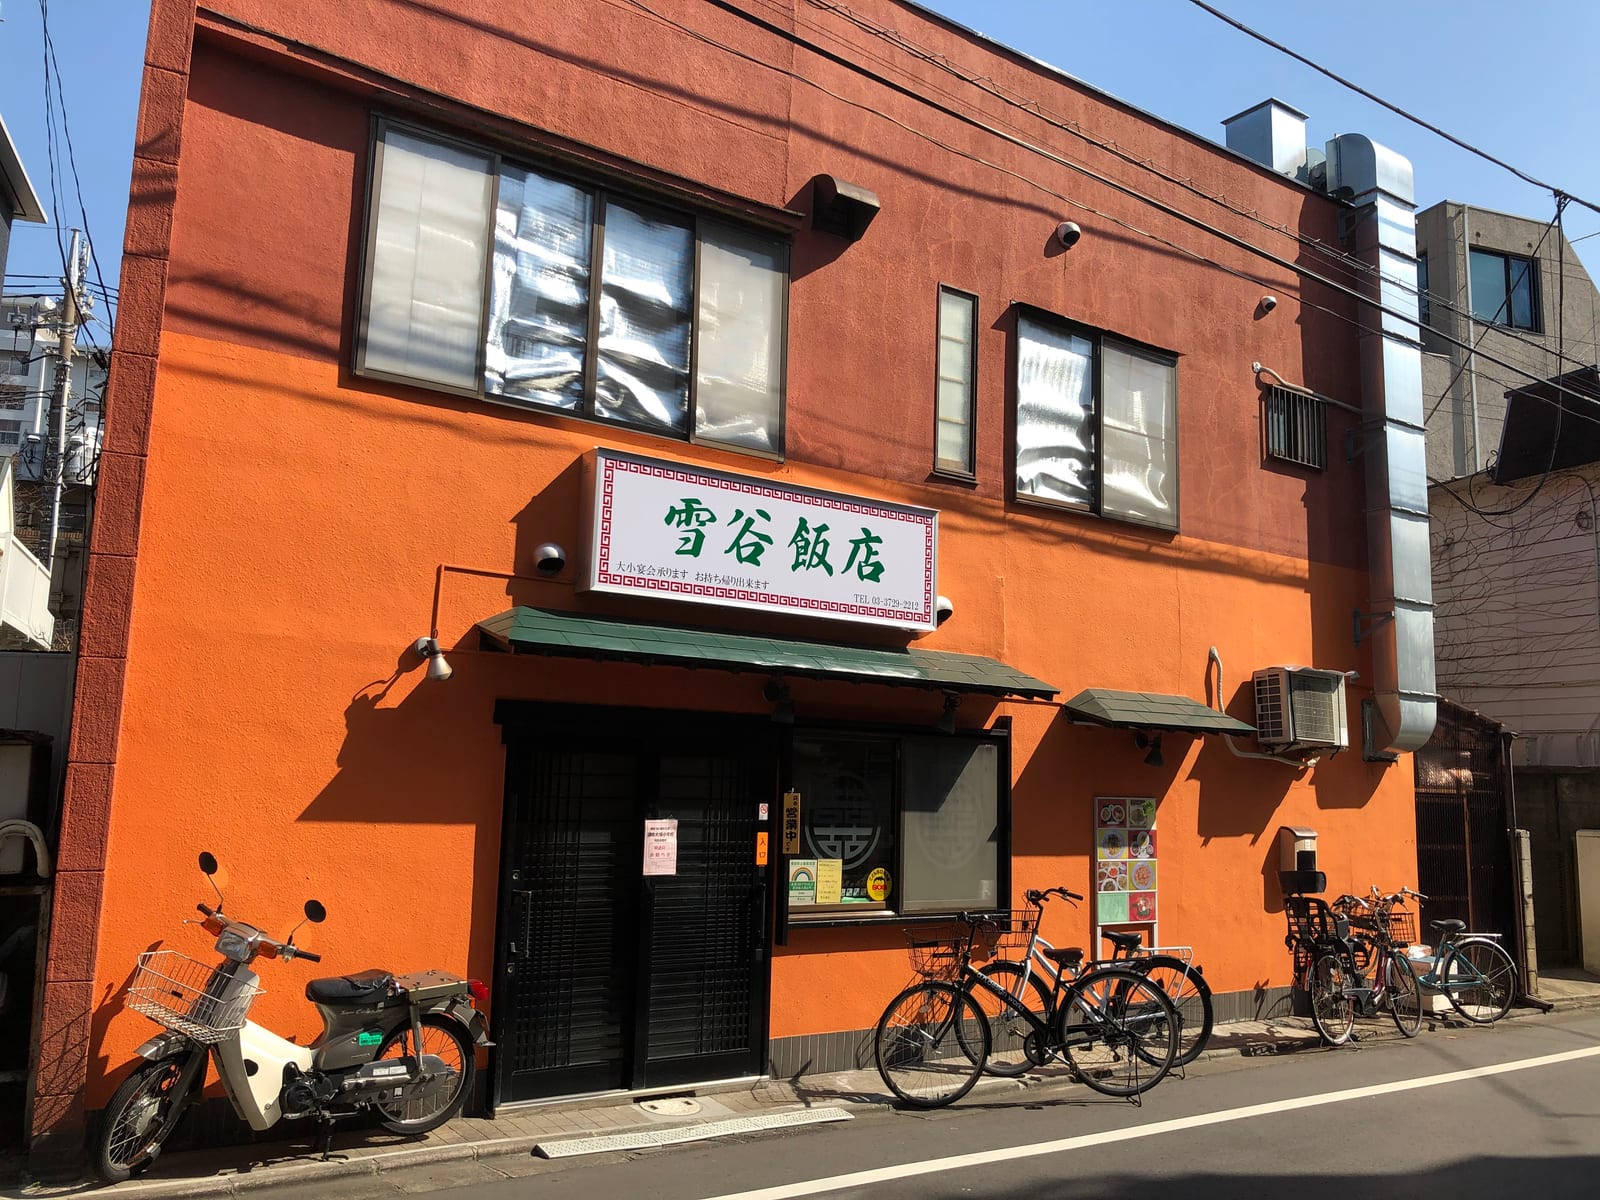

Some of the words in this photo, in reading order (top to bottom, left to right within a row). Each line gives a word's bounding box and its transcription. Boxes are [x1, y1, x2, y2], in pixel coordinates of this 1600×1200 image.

[664, 498, 886, 583] 雪谷飯店
[615, 560, 689, 580] 大小宴会承ります
[695, 571, 770, 591] お持ち帰り出来ます
[854, 593, 869, 605] TEL
[871, 596, 919, 611] 03-3729-2212
[759, 837, 766, 858] 入口
